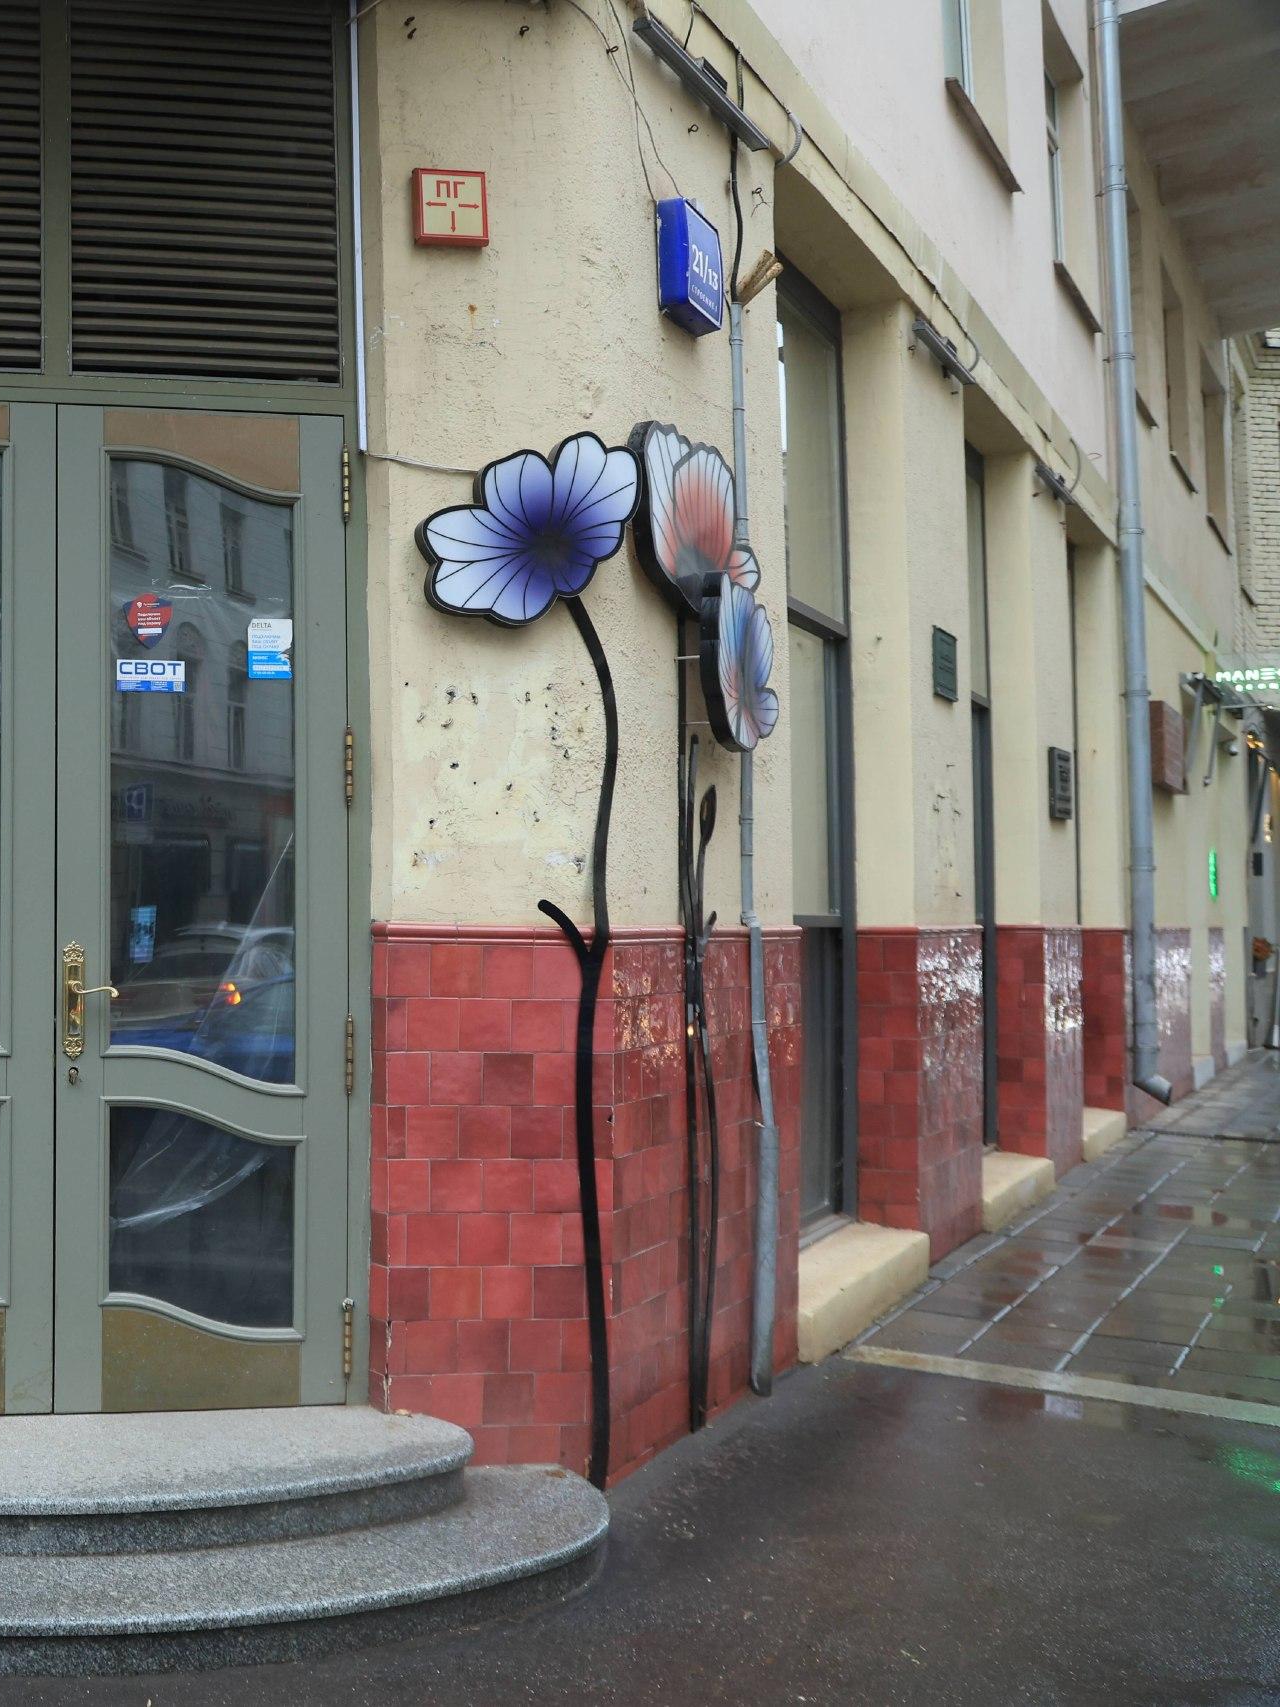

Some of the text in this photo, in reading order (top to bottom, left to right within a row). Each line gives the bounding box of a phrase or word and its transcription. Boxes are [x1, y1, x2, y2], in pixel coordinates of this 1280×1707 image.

[435, 179, 465, 199] ПГ
[692, 244, 719, 291] 21/13
[1215, 667, 1280, 683] MANE
